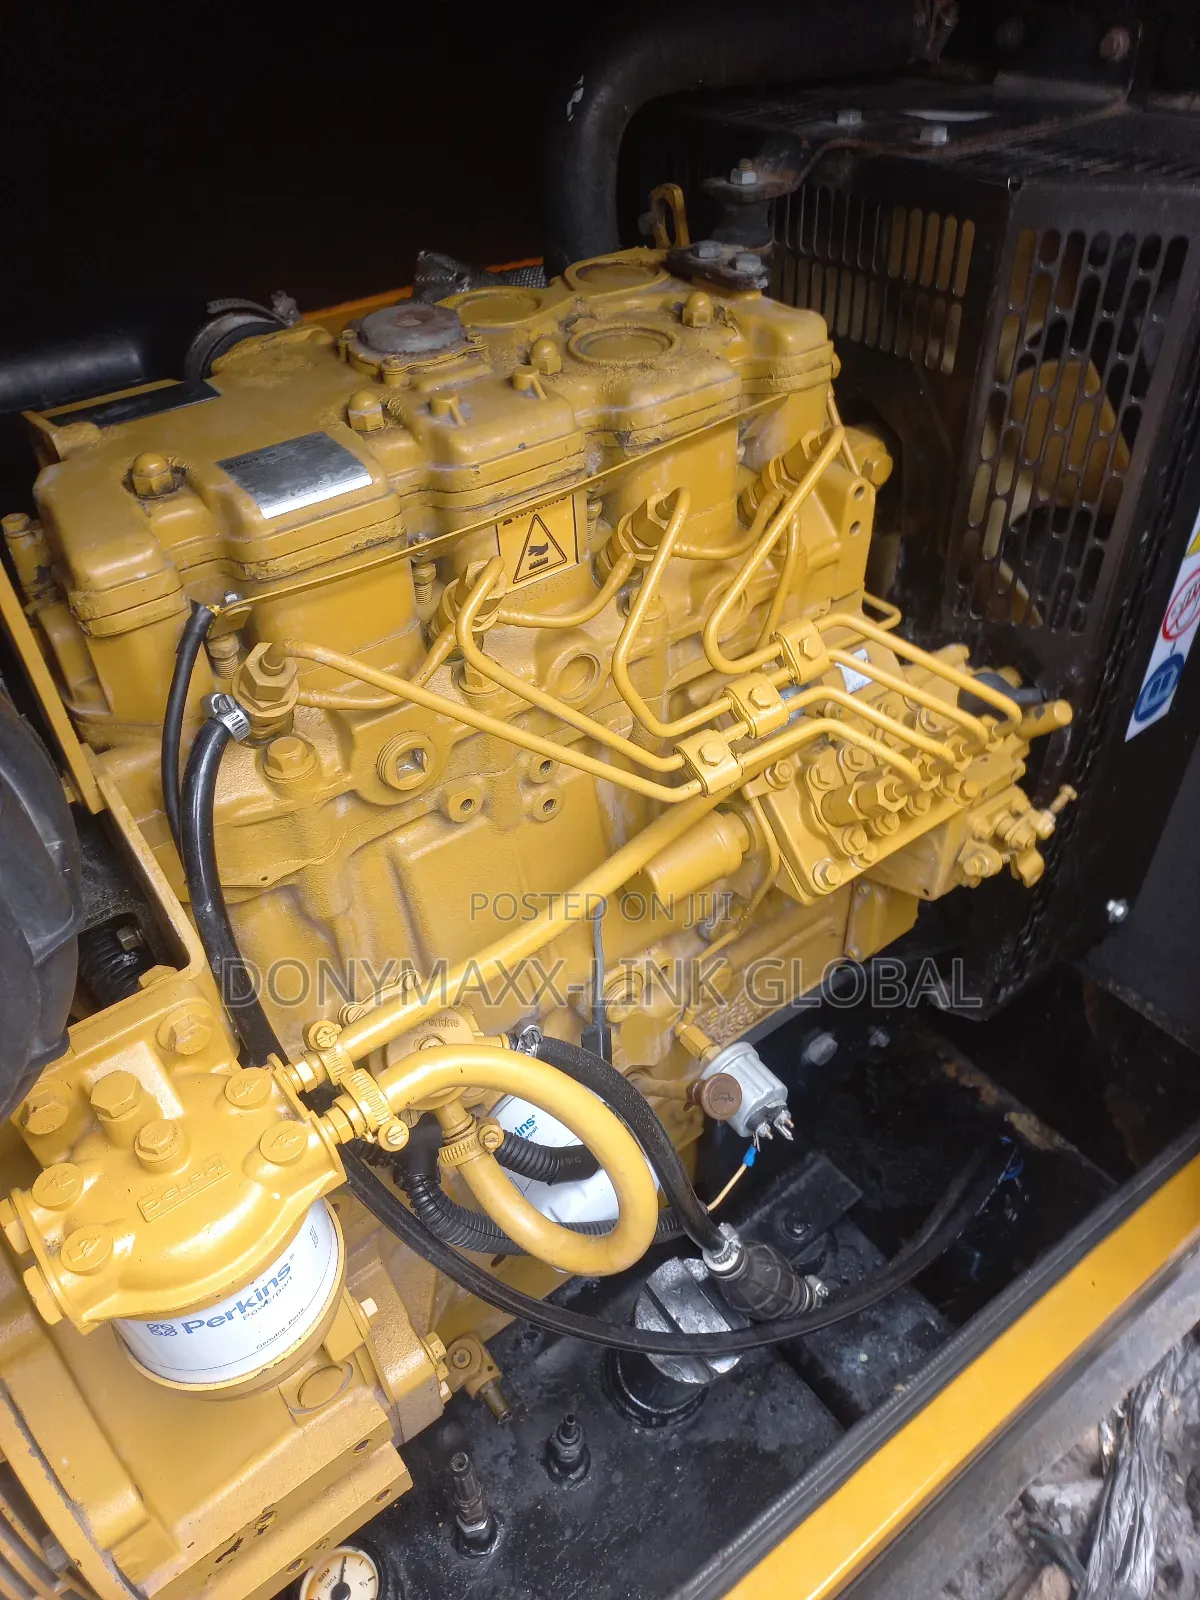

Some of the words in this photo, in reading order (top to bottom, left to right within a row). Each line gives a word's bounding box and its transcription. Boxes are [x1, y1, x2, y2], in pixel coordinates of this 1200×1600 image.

[140, 1155, 226, 1215] DELPHI
[181, 1262, 291, 1335] Perkins
[242, 1275, 293, 1321] Powerpart
[323, 1575, 337, 1590] FUEL
